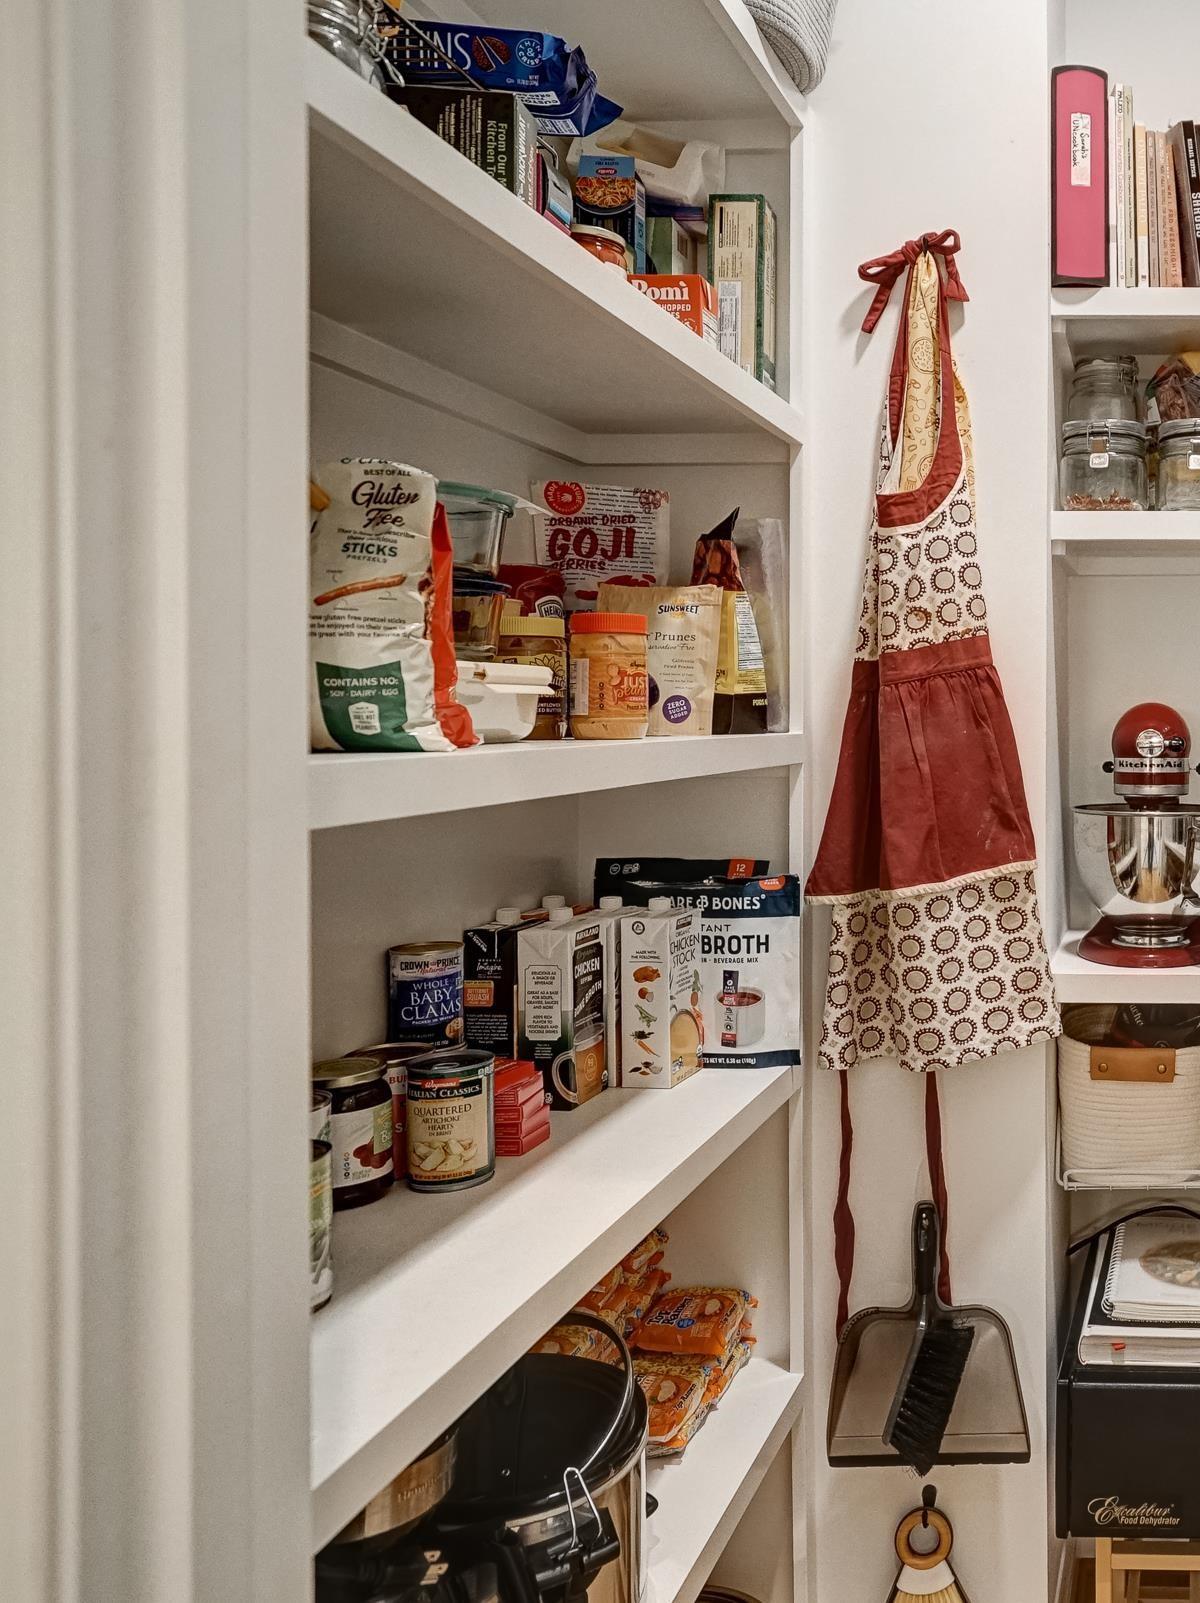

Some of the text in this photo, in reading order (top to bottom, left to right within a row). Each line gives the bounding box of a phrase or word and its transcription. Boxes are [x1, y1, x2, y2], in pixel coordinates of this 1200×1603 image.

[487, 120, 498, 163] Kitchen
[498, 122, 508, 177] From Our
[351, 480, 421, 508] Gluten
[549, 514, 636, 527] ORGANIC DRIED
[341, 542, 398, 557] STICKS
[547, 527, 636, 560] GOJI
[657, 604, 699, 615] SUNSWEET
[654, 632, 696, 642] Prunes
[323, 677, 399, 687] CONTAINS NO:
[350, 689, 377, 697] DAIRY
[666, 700, 685, 710] ZERO
[668, 705, 687, 715] SUGAR
[670, 710, 688, 719] ADDED
[1119, 760, 1182, 768] KitchenAid
[735, 863, 746, 872] 12
[712, 896, 761, 910] BONES
[701, 924, 732, 932] TANT
[670, 933, 701, 955] CHICKEN
[701, 934, 770, 954] BROTH
[401, 956, 460, 971] CROWN PRINCE
[672, 949, 697, 969] STOCK
[574, 956, 600, 979] CHICKEN
[413, 978, 449, 990] WHOLE
[410, 987, 453, 1006] BABY
[401, 998, 461, 1020] CLAMS
[439, 1085, 480, 1097] CLASSICS
[413, 1103, 472, 1117] QUARTERED
[421, 1115, 460, 1124] ARTICHOKE
[1087, 1495, 1171, 1525] Excalibur
[1120, 1516, 1180, 1527] Food Dehydrator
